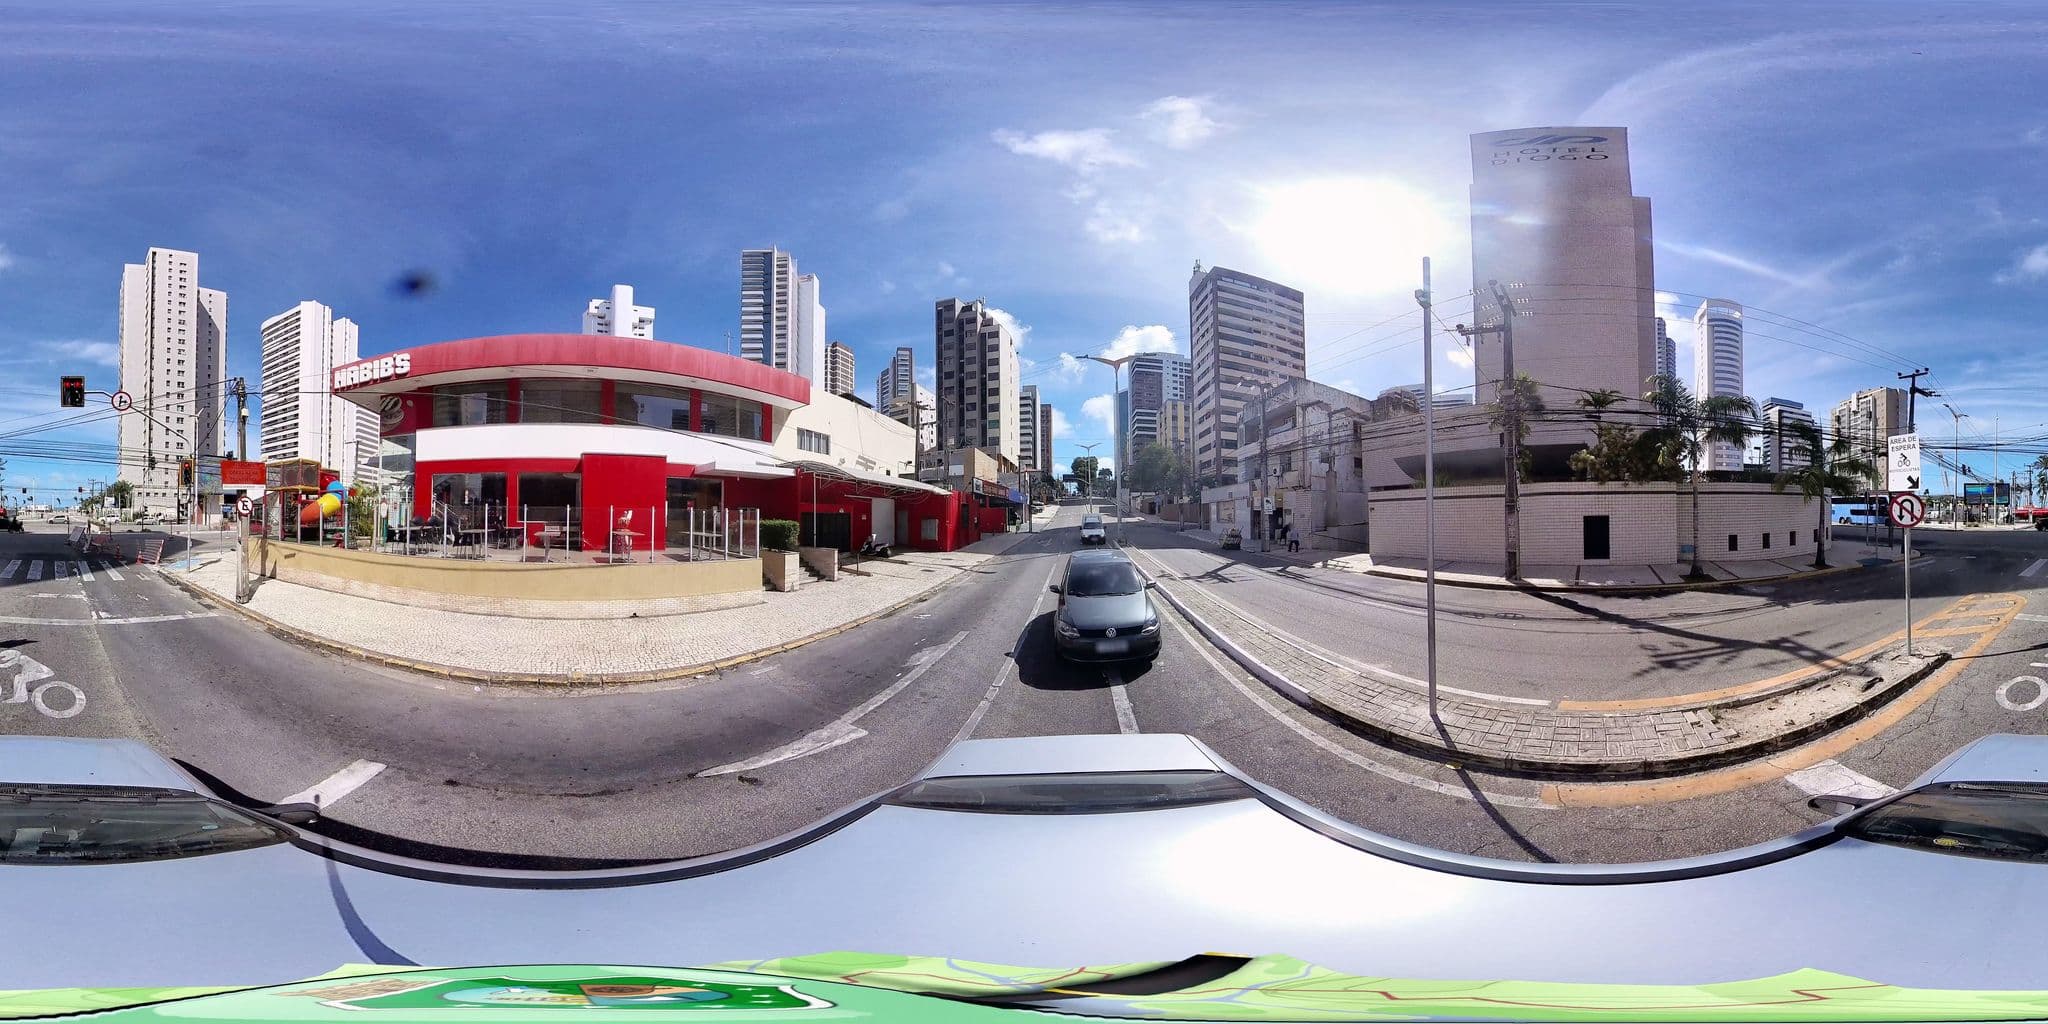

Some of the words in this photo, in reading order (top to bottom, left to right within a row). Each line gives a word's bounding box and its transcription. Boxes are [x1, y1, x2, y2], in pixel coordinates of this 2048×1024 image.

[1493, 147, 1606, 158] HOTEL
[1491, 154, 1609, 166] DIOGO
[334, 353, 411, 389] HABIB'S
[1891, 443, 1916, 452] ESPERA
